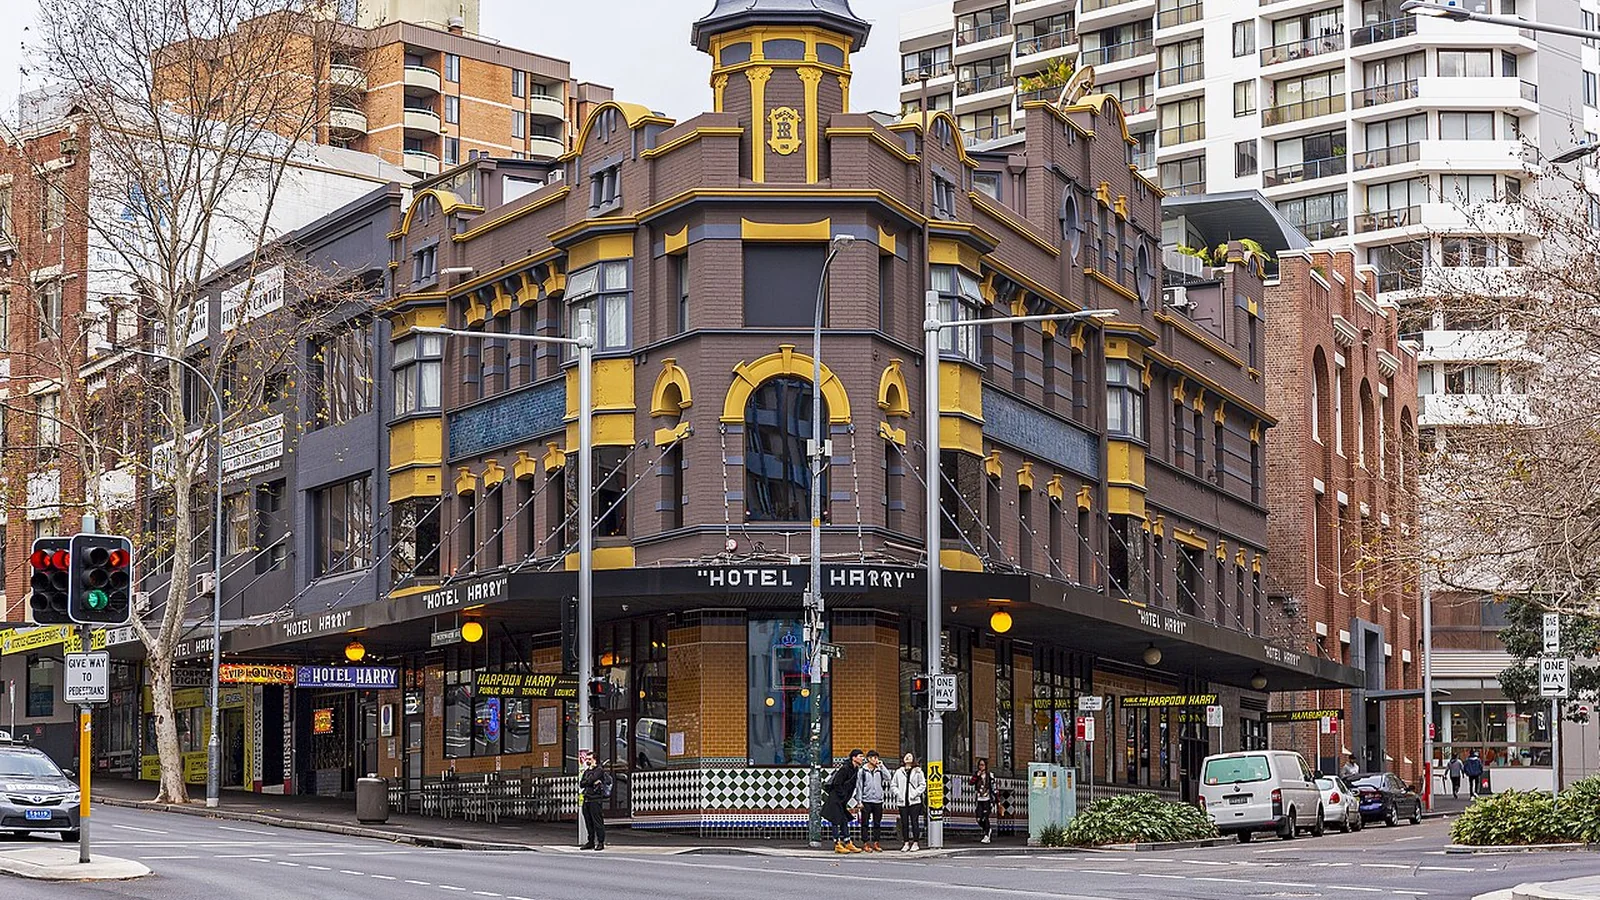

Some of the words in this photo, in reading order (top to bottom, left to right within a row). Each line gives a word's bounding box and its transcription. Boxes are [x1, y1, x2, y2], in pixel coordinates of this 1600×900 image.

[697, 569, 793, 586] "HOTEL
[830, 569, 915, 588] HARRY"
[69, 658, 87, 668] GIVE
[89, 658, 106, 668] WAY
[1544, 661, 1565, 671] ONE
[82, 672, 92, 682] TO
[228, 668, 245, 679] VIP
[246, 667, 289, 680] LOUNGE
[313, 667, 352, 683] HOTEL
[356, 668, 396, 684] HARRY
[1543, 673, 1566, 683] WAY
[477, 673, 521, 686] HARPOON
[525, 675, 557, 687] HARRY
[936, 678, 954, 687] ONE
[478, 687, 500, 695] PUBLIC
[501, 687, 515, 695] BAR
[522, 688, 548, 696] TERRACE
[554, 688, 576, 697] LOUNGE
[936, 689, 954, 697] WAY
[1148, 696, 1187, 707] HARPOON
[1188, 694, 1217, 705] HARRY
[1291, 710, 1339, 720] HAMBURGERS
